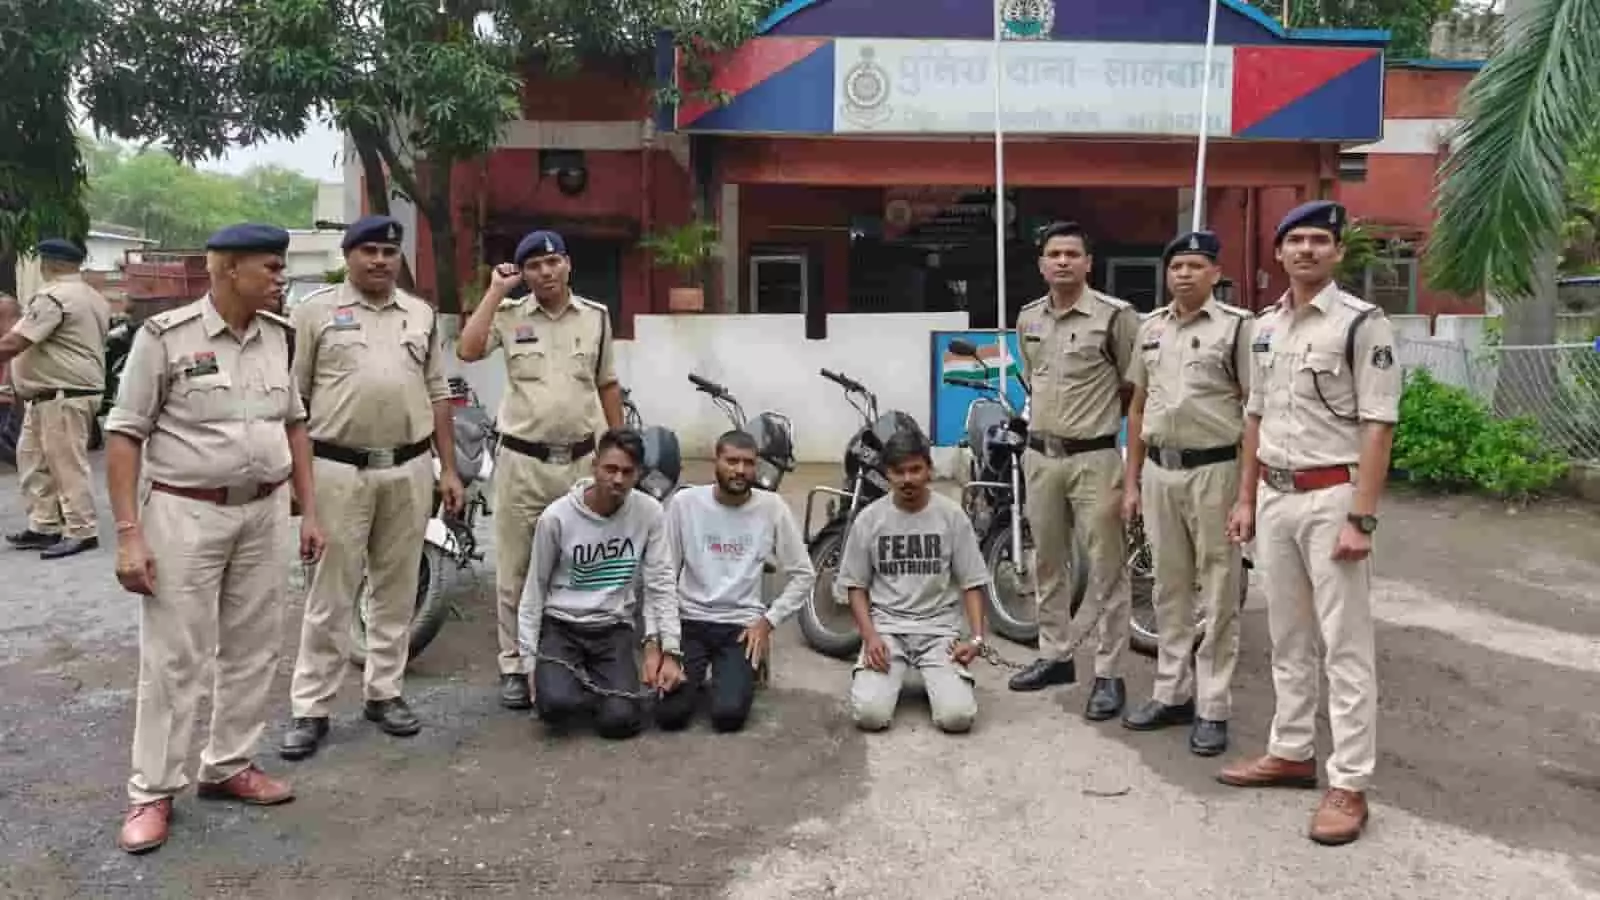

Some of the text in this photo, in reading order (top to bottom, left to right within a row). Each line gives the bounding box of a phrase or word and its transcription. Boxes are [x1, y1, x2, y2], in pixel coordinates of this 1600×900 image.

[573, 537, 634, 565] NASA
[878, 533, 941, 560] FEAR
[879, 559, 941, 575] NOTHING
